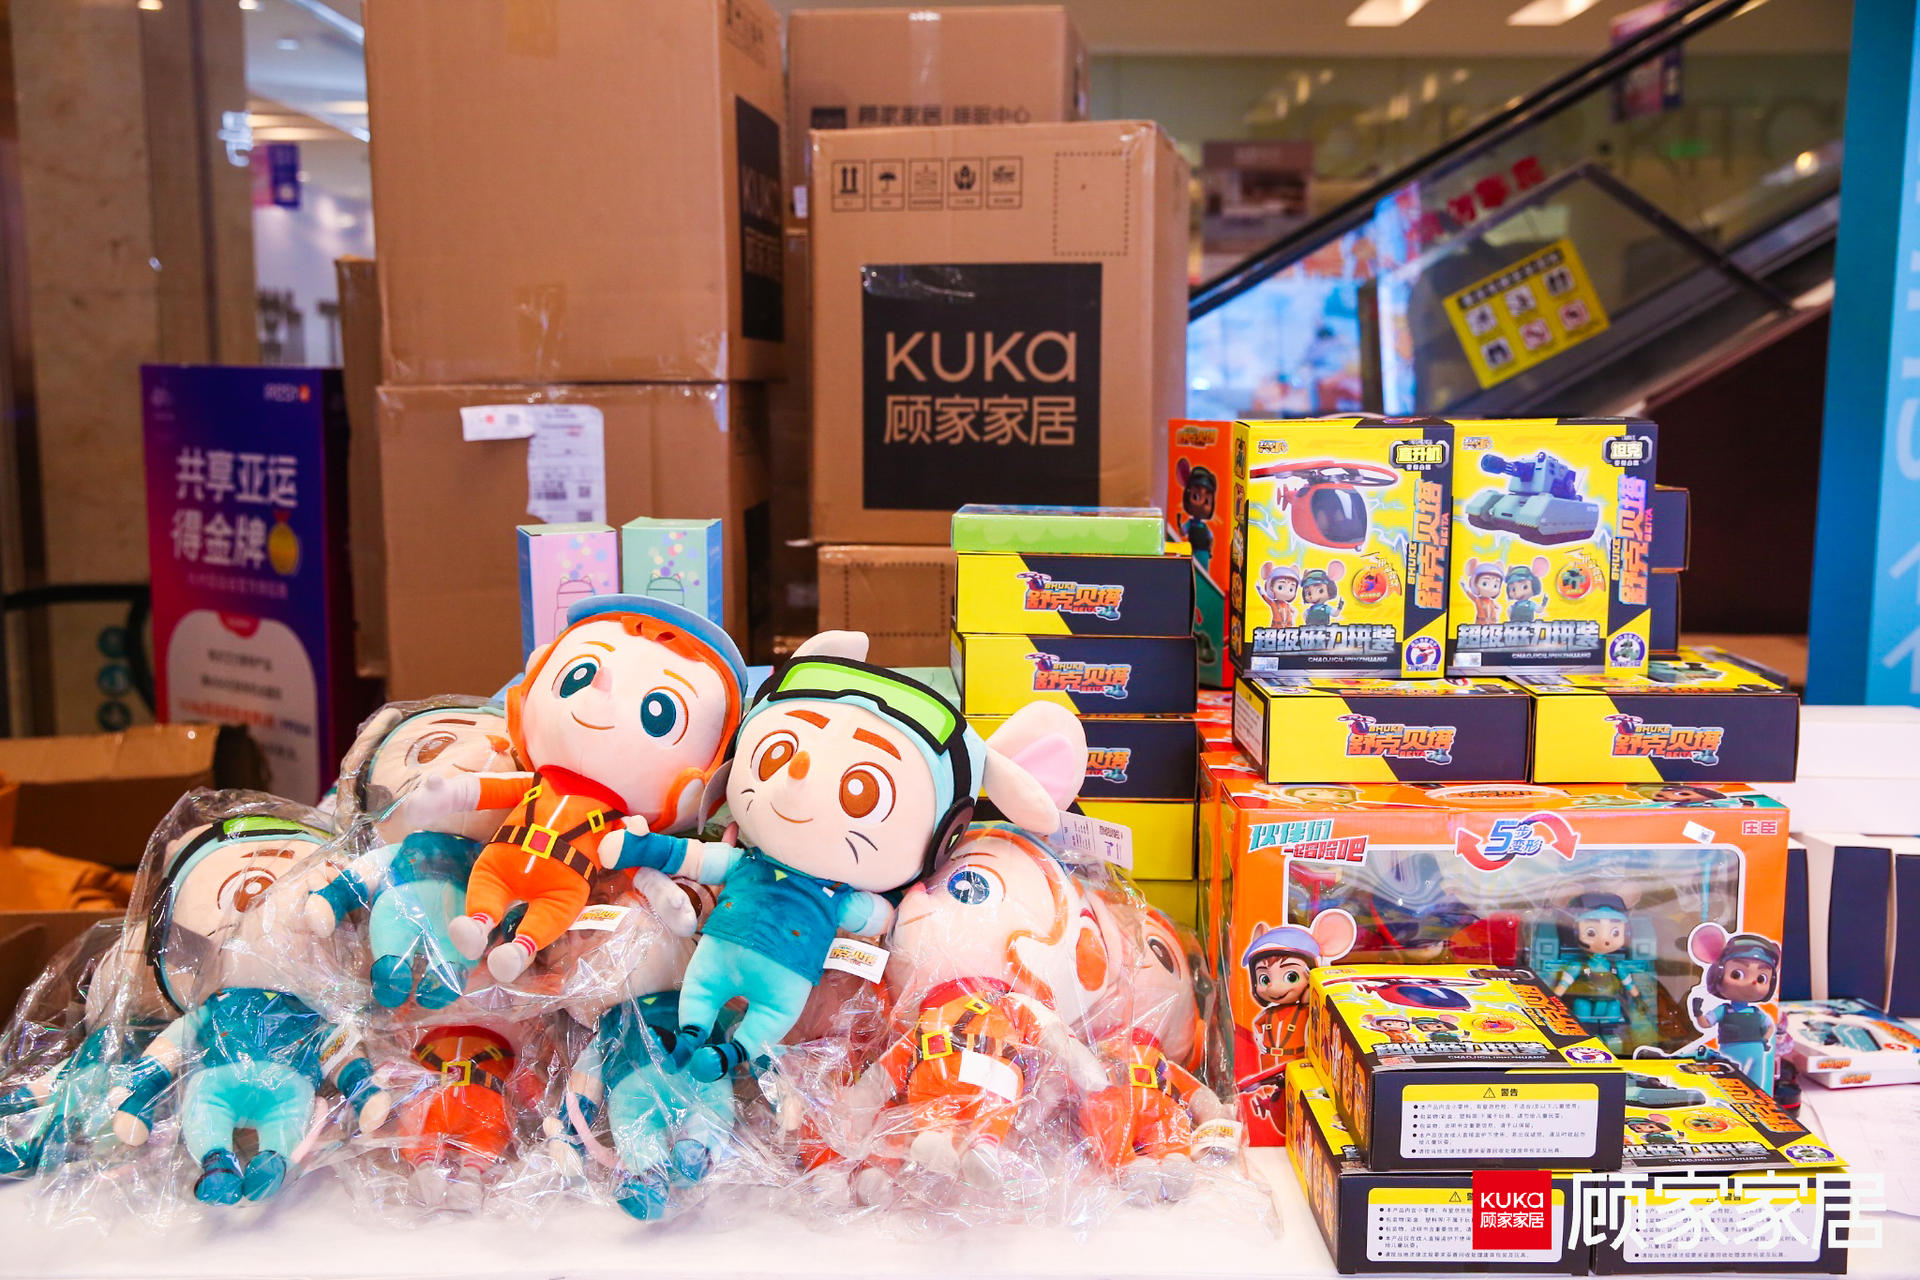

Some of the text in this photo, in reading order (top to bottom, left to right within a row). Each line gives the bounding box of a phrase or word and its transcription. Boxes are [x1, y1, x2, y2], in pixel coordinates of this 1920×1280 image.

[884, 396, 1078, 446] 顾家家居
[1398, 447, 1441, 462] 直升机
[1612, 442, 1643, 458] 坦克
[174, 447, 299, 508] 共享亚运
[172, 511, 267, 571] 得金牌
[1415, 480, 1443, 609] 舒克贝塔
[1618, 475, 1648, 605] 舒克贝塔
[1611, 538, 1620, 581] SHUKE
[1026, 587, 1123, 610] 舒克贝塔
[1253, 625, 1395, 652] 超级磁力拼装
[1457, 620, 1599, 649] 超级磁力拼装
[1034, 667, 1130, 690] 舒克贝塔
[1347, 729, 1455, 755] 舒克贝塔
[1614, 730, 1722, 756] 舒克贝塔
[1250, 820, 1333, 851] 伙伴们
[1742, 821, 1777, 835] 庄臣
[1284, 837, 1367, 862] 一起冒险吧
[1373, 1041, 1550, 1057] 超级磁力拼装
[1501, 1088, 1519, 1097] 警告
